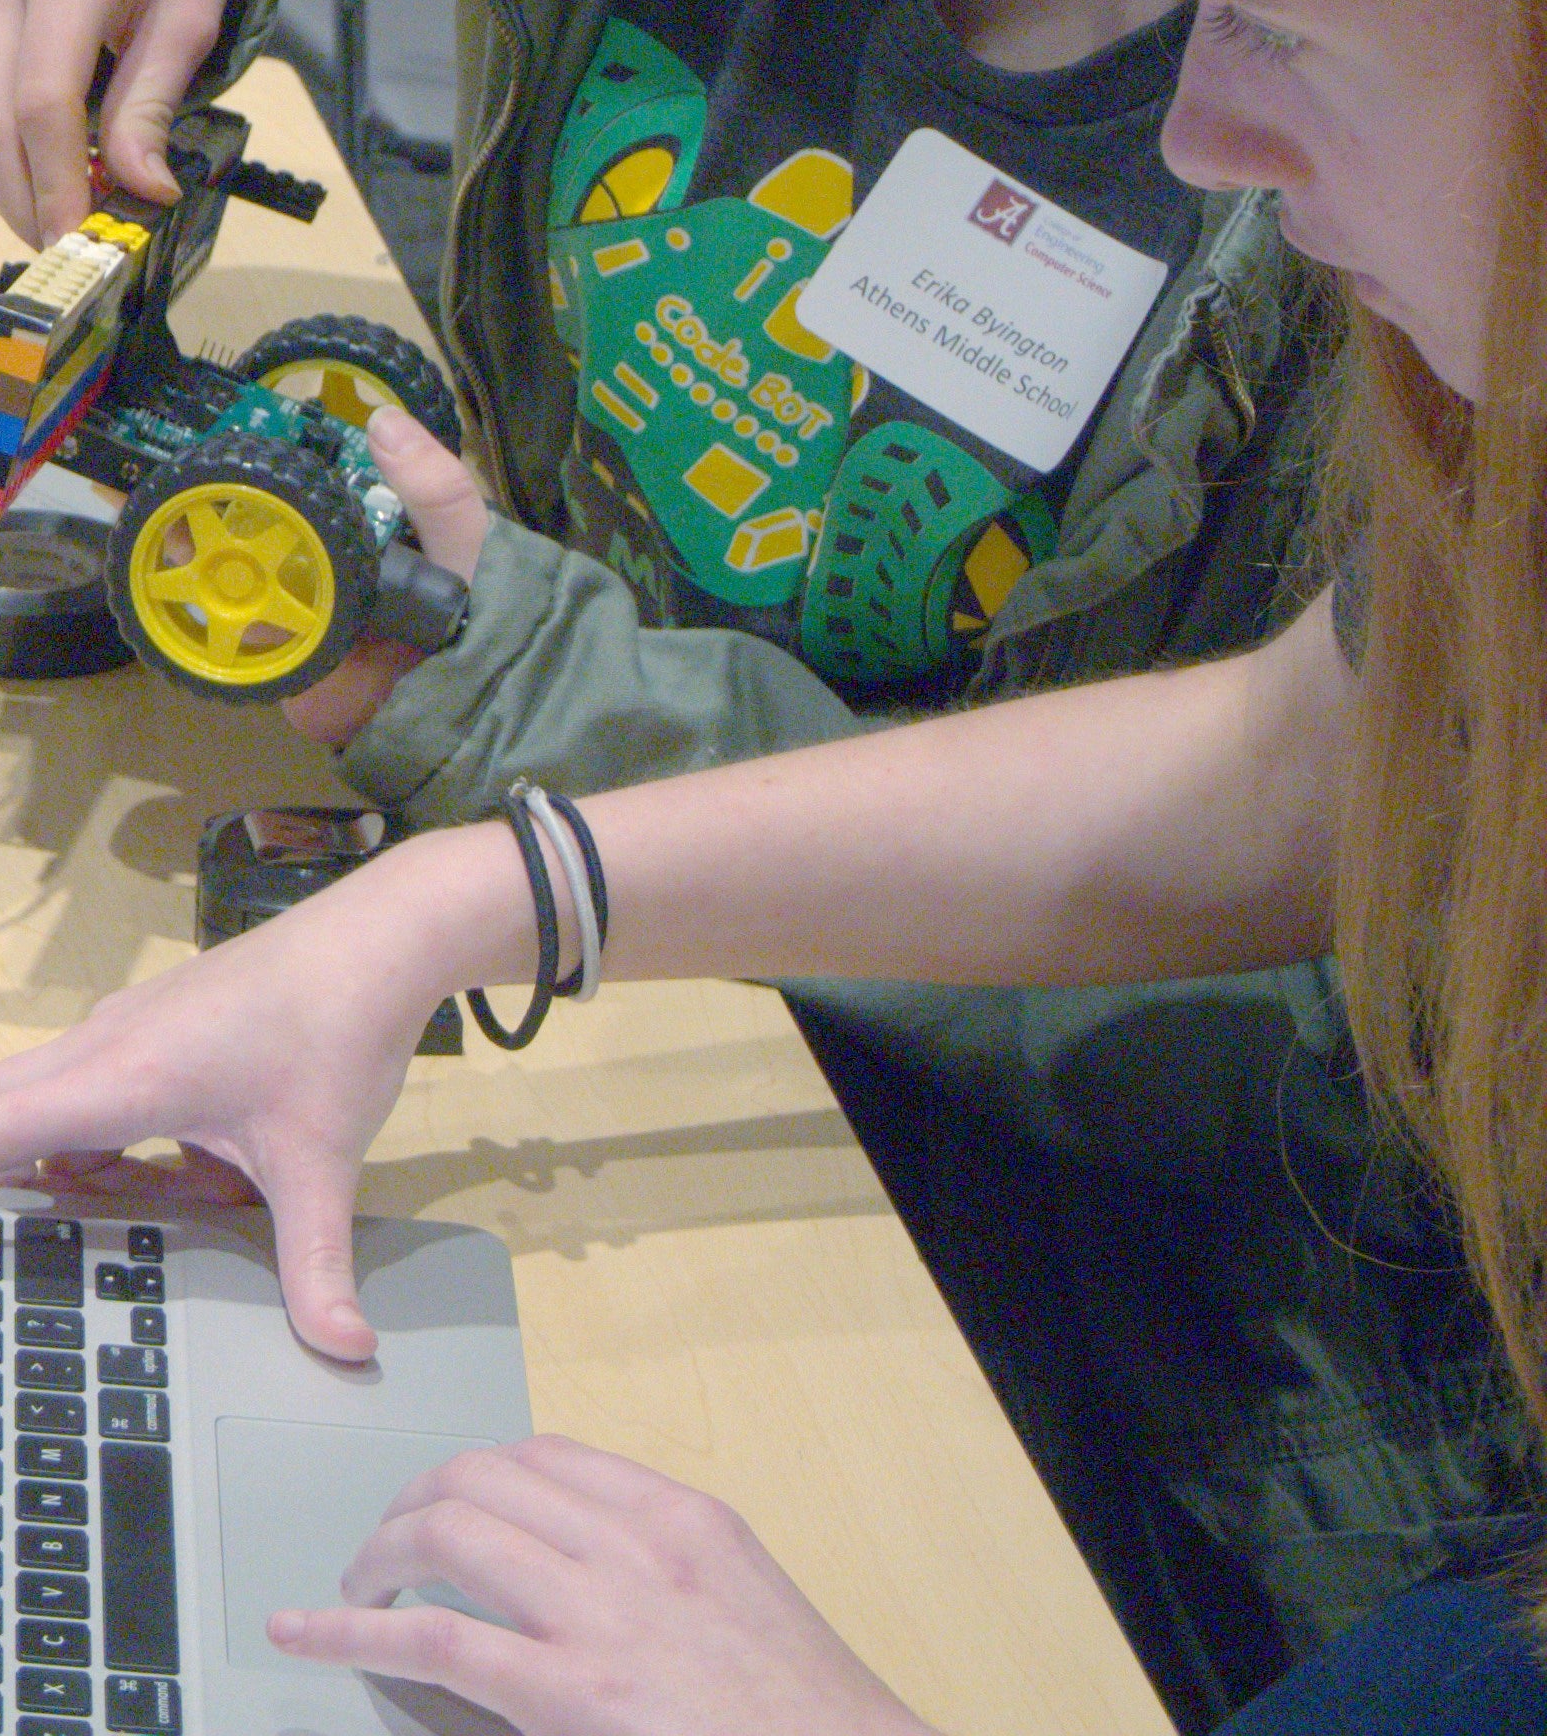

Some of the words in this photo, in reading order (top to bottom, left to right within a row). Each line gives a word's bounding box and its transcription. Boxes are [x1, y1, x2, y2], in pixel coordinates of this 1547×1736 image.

[1034, 224, 1104, 275] Engineering
[1025, 241, 1076, 278] Computer
[1077, 271, 1112, 298] Science
[911, 269, 972, 314] Erika
[971, 306, 1069, 374] Byington
[849, 275, 931, 334] Athens
[933, 325, 1012, 384] Middle
[1013, 374, 1079, 421] School
[40, 1448, 62, 1462] M
[41, 1493, 62, 1507] N
[41, 1541, 64, 1552] B
[42, 1586, 64, 1597] V
[41, 1634, 65, 1647] C
[43, 1682, 65, 1695] X
[154, 1681, 169, 1724] command
